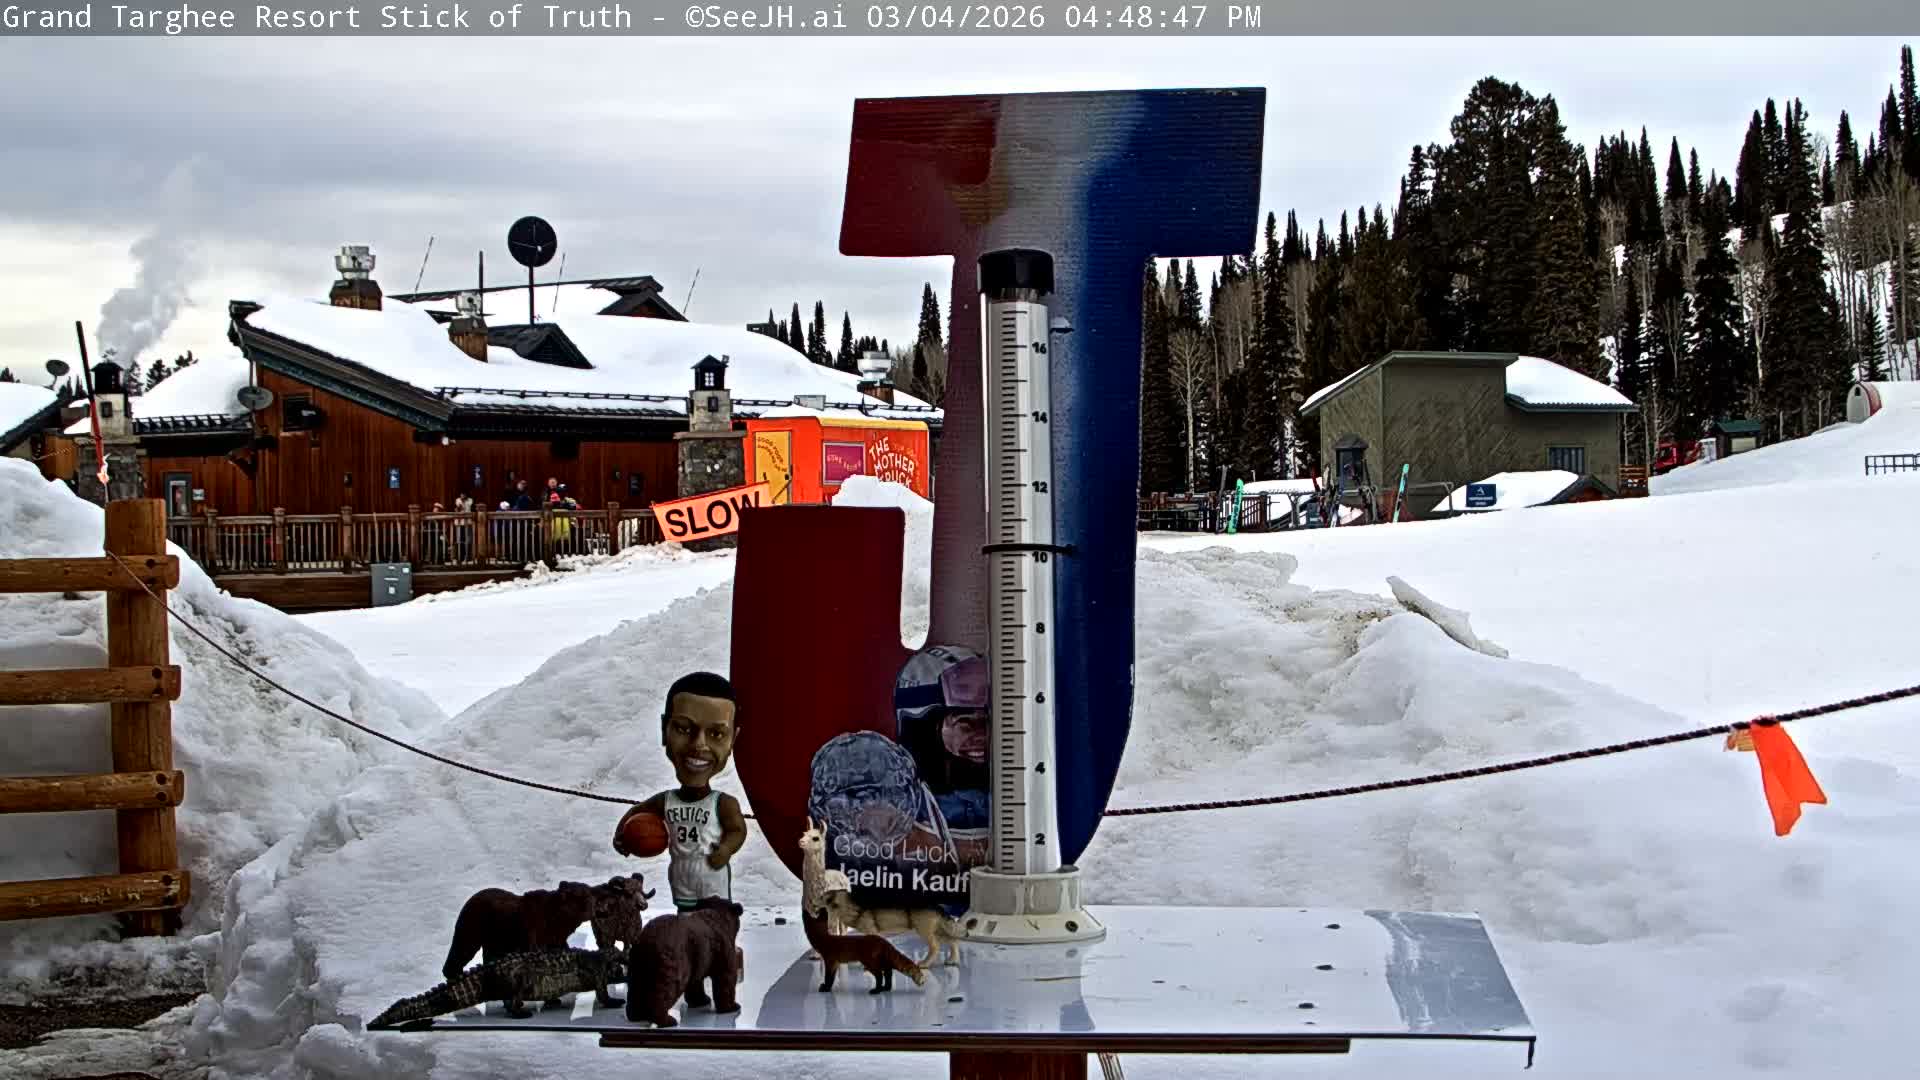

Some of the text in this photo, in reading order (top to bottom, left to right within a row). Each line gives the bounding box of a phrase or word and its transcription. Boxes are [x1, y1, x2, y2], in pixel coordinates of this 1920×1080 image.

[1031, 341, 1047, 355] 16
[1031, 411, 1048, 424] 14
[869, 436, 890, 461] THE
[874, 453, 915, 478] MOTHER
[880, 469, 912, 488] RUCK
[1031, 481, 1048, 493] 12
[665, 490, 760, 537] SLOW
[1031, 551, 1048, 563] 10
[1035, 621, 1046, 634] 8
[1034, 691, 1046, 704] 6
[1034, 761, 1046, 774] 4
[667, 806, 710, 824] CELTICS
[677, 825, 699, 843] 34
[1034, 832, 1046, 845] 2
[833, 834, 959, 863] Good Luck
[912, 868, 970, 893] Kauf
